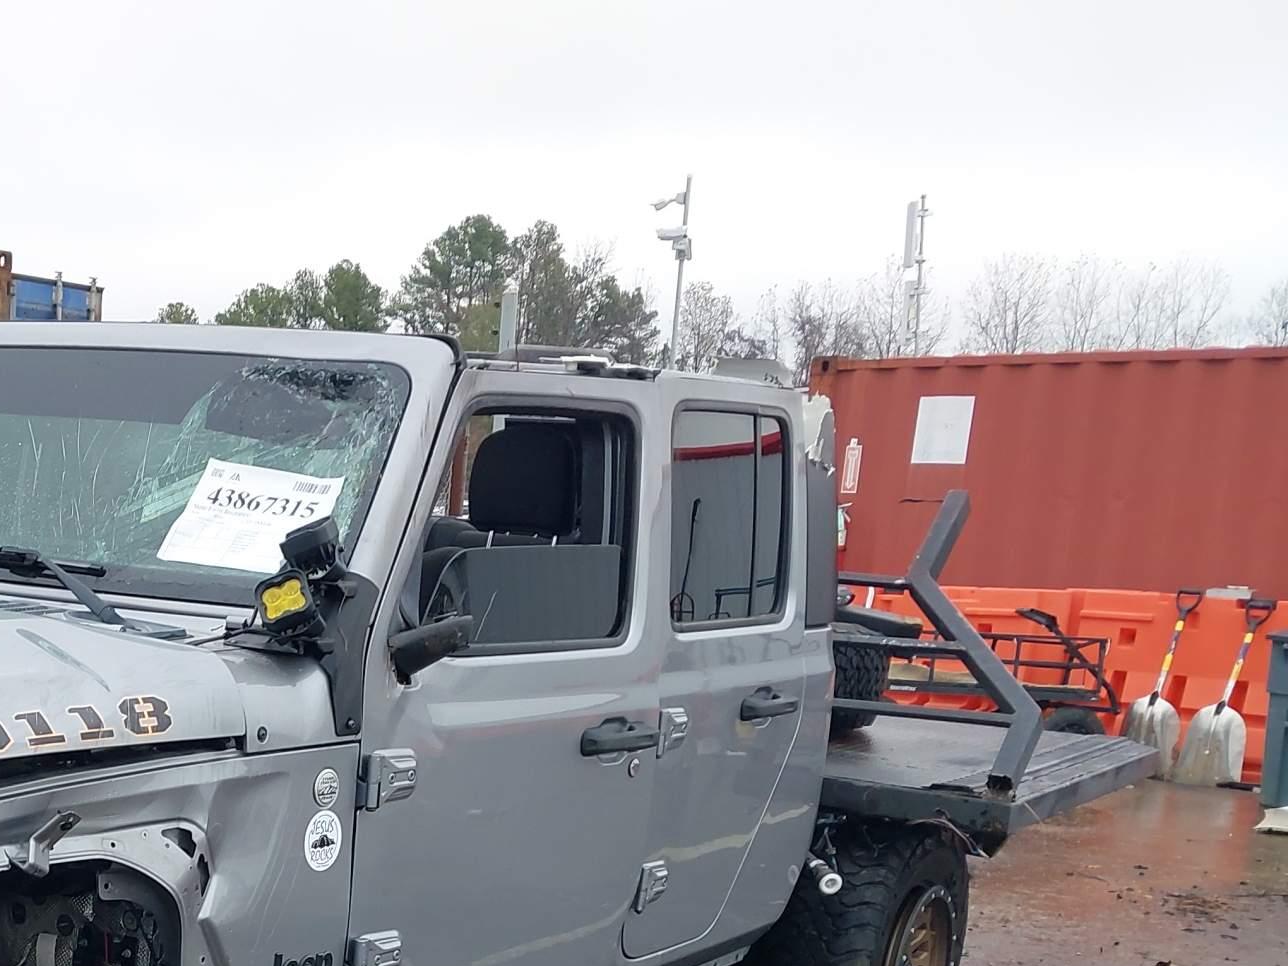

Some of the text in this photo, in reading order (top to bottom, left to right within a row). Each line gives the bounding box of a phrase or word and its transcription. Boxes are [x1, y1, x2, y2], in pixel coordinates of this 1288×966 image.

[207, 487, 320, 519] 43867315
[311, 817, 335, 836] JESUS
[311, 847, 334, 862] ROCKS
